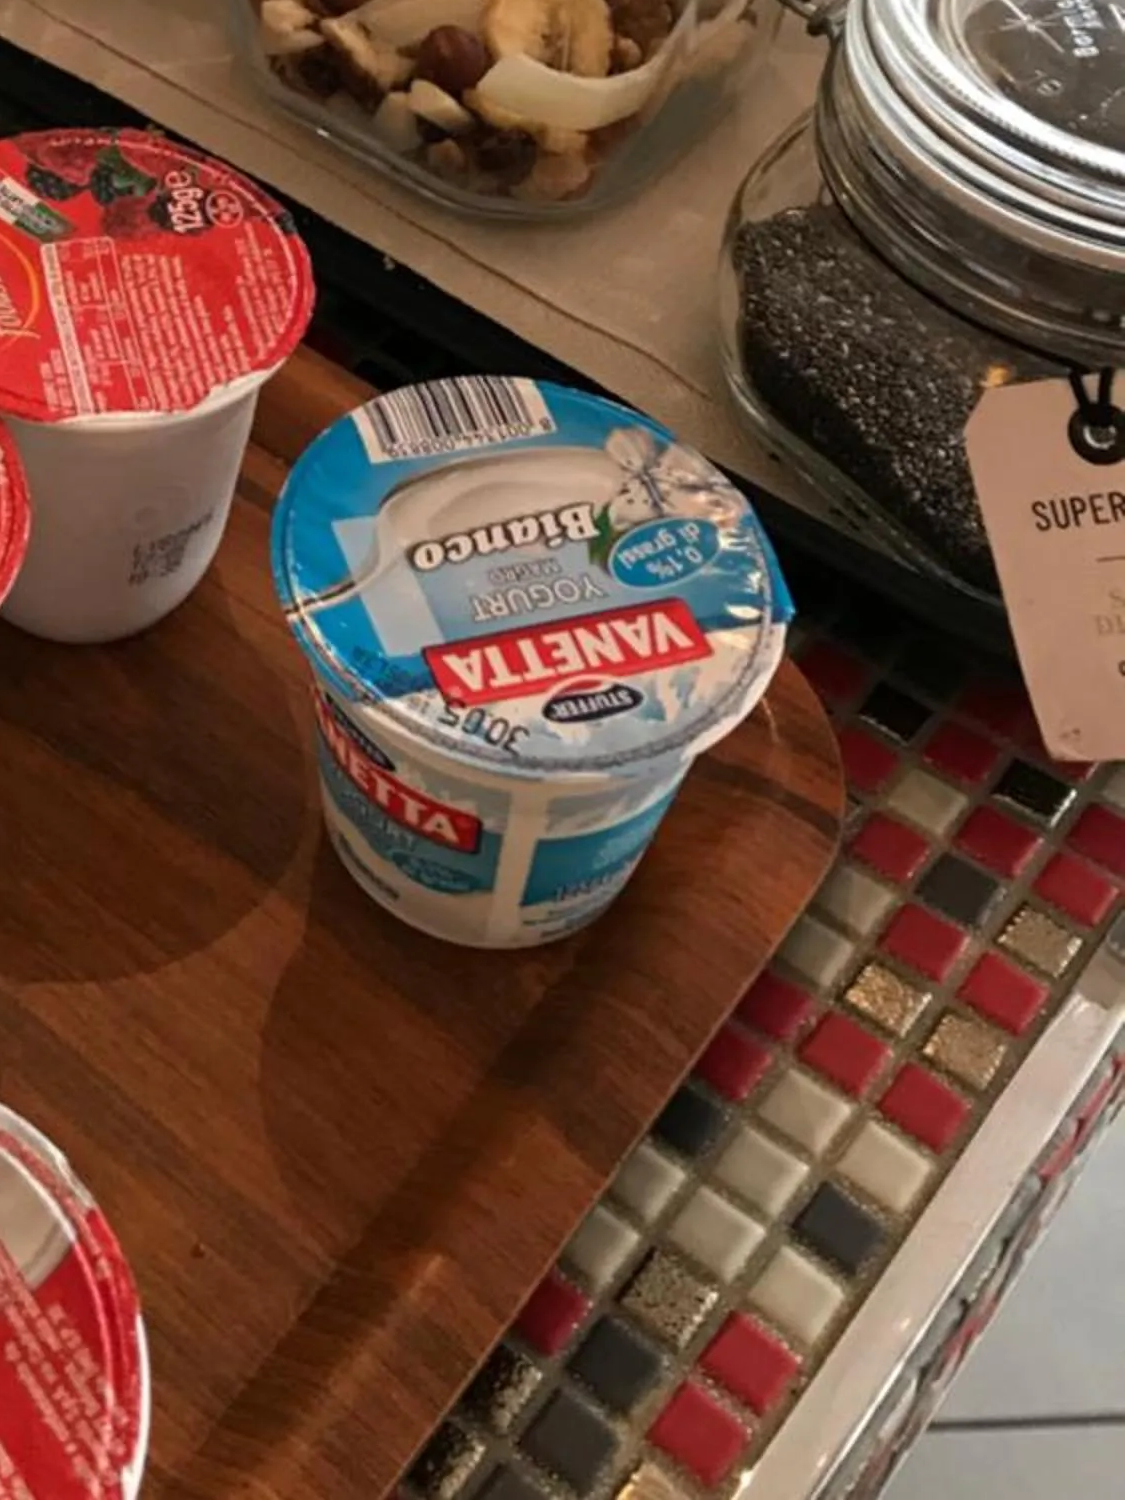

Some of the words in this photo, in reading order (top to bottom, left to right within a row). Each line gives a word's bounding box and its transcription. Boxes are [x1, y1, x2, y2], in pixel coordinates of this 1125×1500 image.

[413, 503, 601, 571] Bianco
[470, 576, 606, 622] YOGURT
[442, 610, 697, 694] VANETTA
[551, 688, 633, 719] STUFFER
